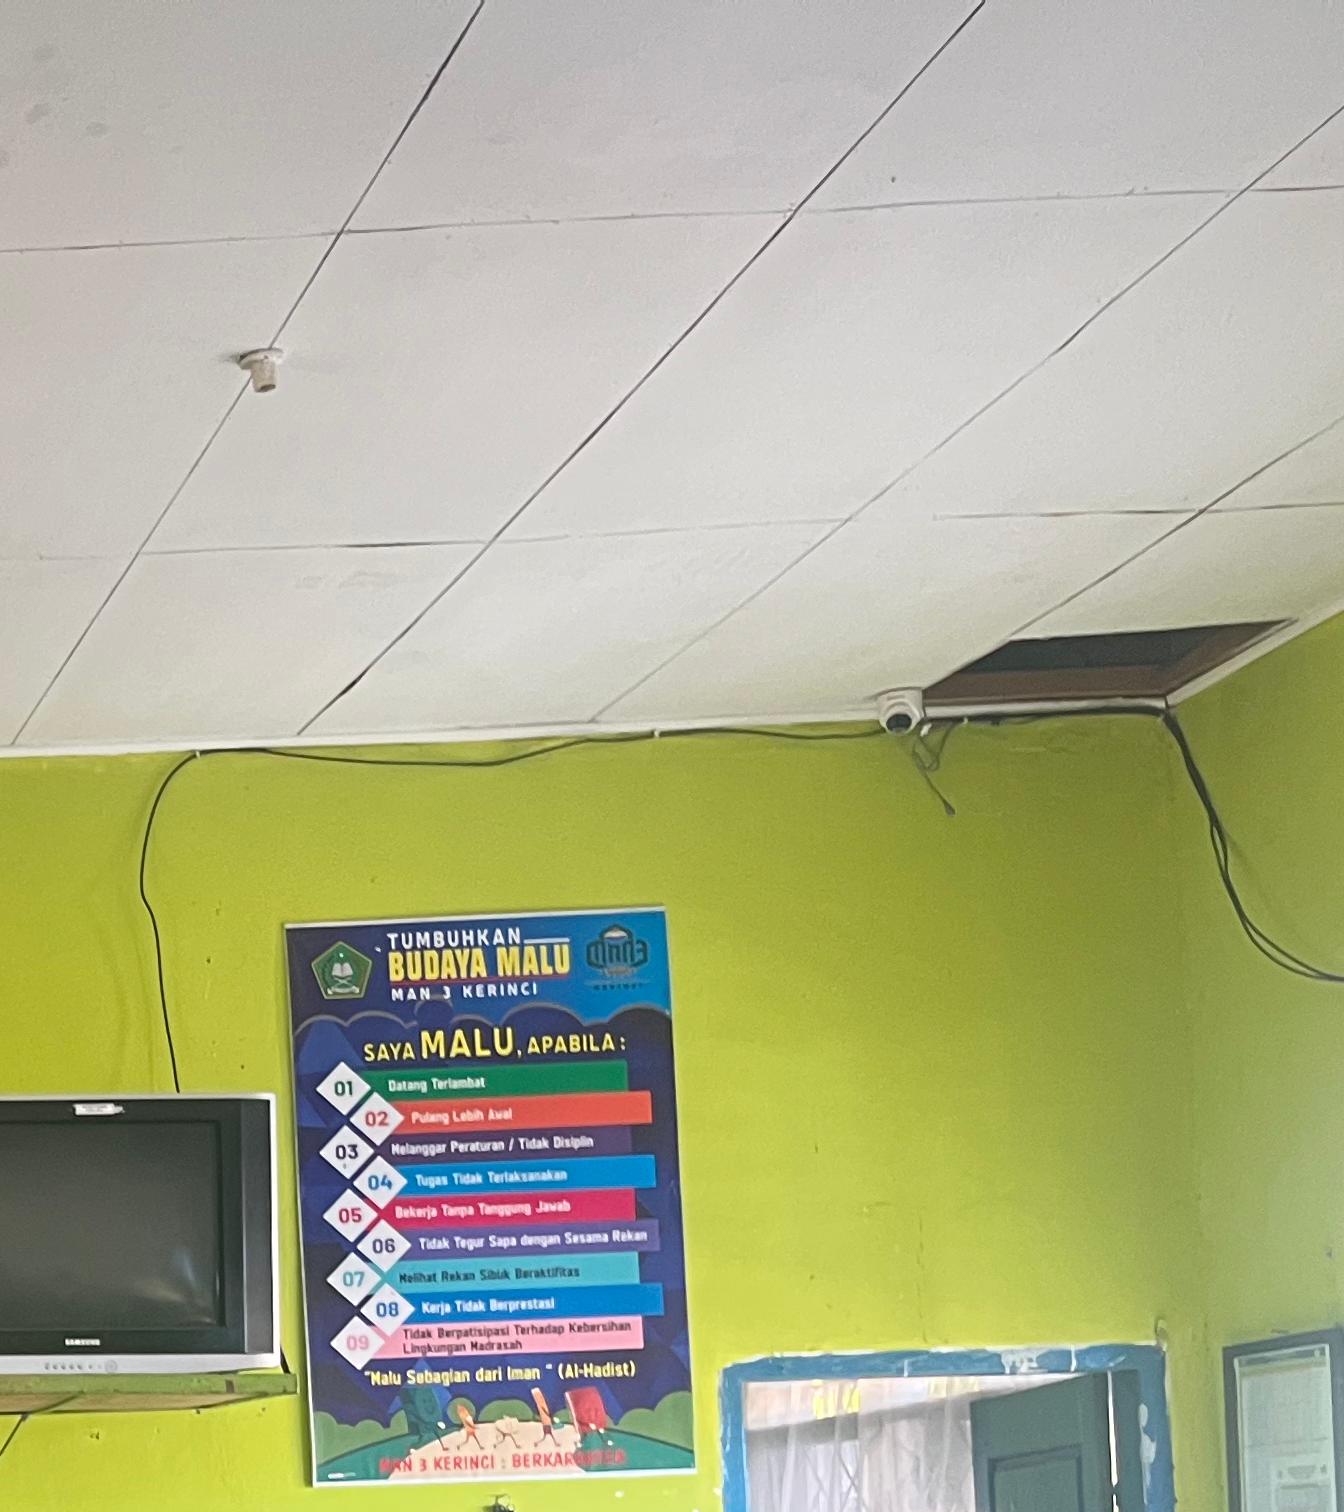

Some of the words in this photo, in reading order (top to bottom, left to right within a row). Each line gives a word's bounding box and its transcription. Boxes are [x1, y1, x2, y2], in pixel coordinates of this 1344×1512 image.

[387, 928, 520, 949] TUMBUHKAN
[389, 948, 487, 982] BUDAYA
[497, 946, 570, 977] MALU
[391, 987, 431, 1001] MAN
[443, 987, 451, 1000] 3
[463, 984, 537, 998] KERINCI
[364, 1043, 414, 1062] SAYA
[422, 1028, 521, 1059] MALU,
[527, 1034, 615, 1053] APABILA
[334, 1081, 353, 1096] 01
[389, 1079, 427, 1093] Datang
[432, 1076, 485, 1090] Terlambat
[366, 1112, 389, 1126] 02
[412, 1110, 449, 1126] Pulang
[453, 1109, 484, 1122] Lebih
[488, 1108, 512, 1121] Awal
[336, 1144, 358, 1159] 03
[392, 1141, 447, 1156] Melanggar
[451, 1139, 504, 1154] Peraturan
[519, 1137, 549, 1150] Tidak
[554, 1135, 593, 1150] Disiplin
[368, 1176, 392, 1190] 04
[416, 1174, 448, 1188] Tugas
[454, 1173, 484, 1185] Tidak
[489, 1169, 567, 1184] Terlaksanakan
[339, 1209, 362, 1223] 05
[396, 1204, 438, 1220] Bekerja
[442, 1203, 474, 1217] Tanpa
[479, 1202, 531, 1217] Tanggung
[535, 1200, 570, 1214] Jawab
[372, 1238, 395, 1254] 06
[419, 1237, 449, 1249] Tidak
[455, 1235, 484, 1251] Tegur
[489, 1234, 517, 1249] Sapa
[521, 1233, 560, 1248] dengan
[565, 1232, 608, 1245] Sesama
[612, 1230, 647, 1243] Rekan
[342, 1272, 365, 1287] 07
[400, 1270, 437, 1284] Melihat
[442, 1269, 476, 1282] Rekan
[480, 1267, 510, 1281] Sibuk
[515, 1266, 579, 1279] Beraktifitas
[376, 1302, 399, 1317] 08
[422, 1300, 451, 1316] Kerja
[457, 1299, 486, 1312] Tidak
[490, 1297, 555, 1313] Berprestasi
[347, 1335, 369, 1351] 09
[404, 1328, 433, 1340] Tidak
[515, 1324, 565, 1337] Terhadap
[569, 1321, 631, 1334] Kebersihan
[403, 1342, 467, 1357] Lingkungan
[471, 1340, 522, 1353] Madrasah
[407, 1368, 471, 1387] Sebagian
[476, 1368, 502, 1383] dari
[420, 1458, 426, 1471] 3
[434, 1455, 495, 1470] KERINCI
